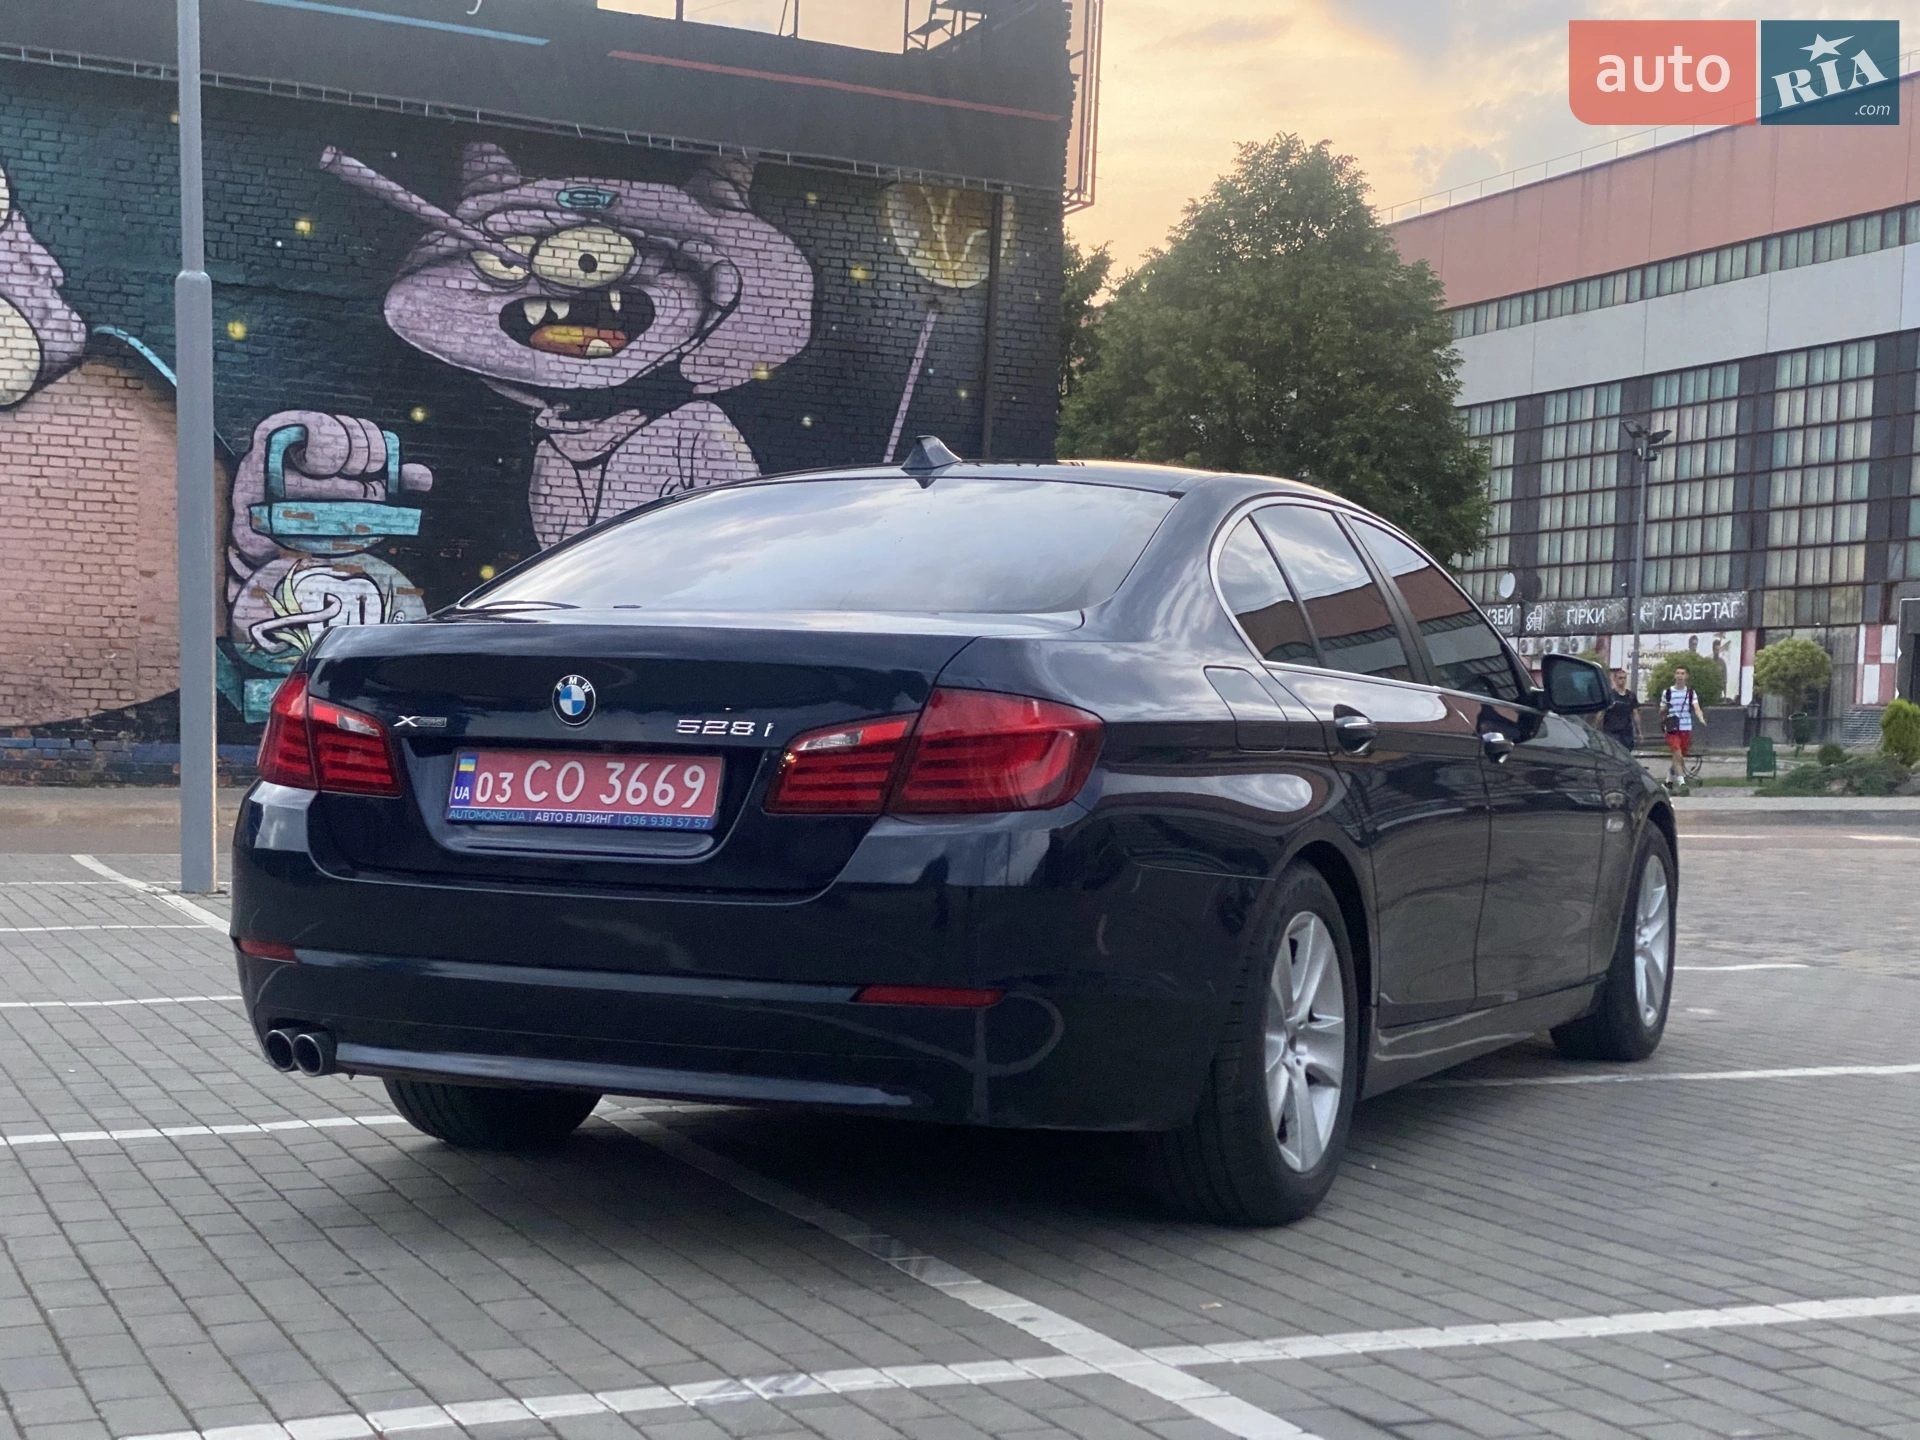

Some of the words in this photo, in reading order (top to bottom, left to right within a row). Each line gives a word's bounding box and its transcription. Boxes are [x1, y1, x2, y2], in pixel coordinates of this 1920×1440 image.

[1662, 600, 1740, 621] ЛАЗЕРТАГ
[556, 676, 592, 693] BMW
[475, 771, 515, 803] 03
[523, 759, 585, 803] CO
[599, 762, 706, 809] 3669
[454, 786, 470, 800] UA
[448, 808, 526, 820] AUTOMONEY.UA
[534, 811, 564, 823] АВТО
[565, 812, 573, 823] В
[574, 813, 615, 825] ЛІЗИНГ
[623, 814, 647, 826] 096
[650, 815, 673, 827] 938
[676, 816, 691, 827] 57
[694, 818, 709, 828] 57
